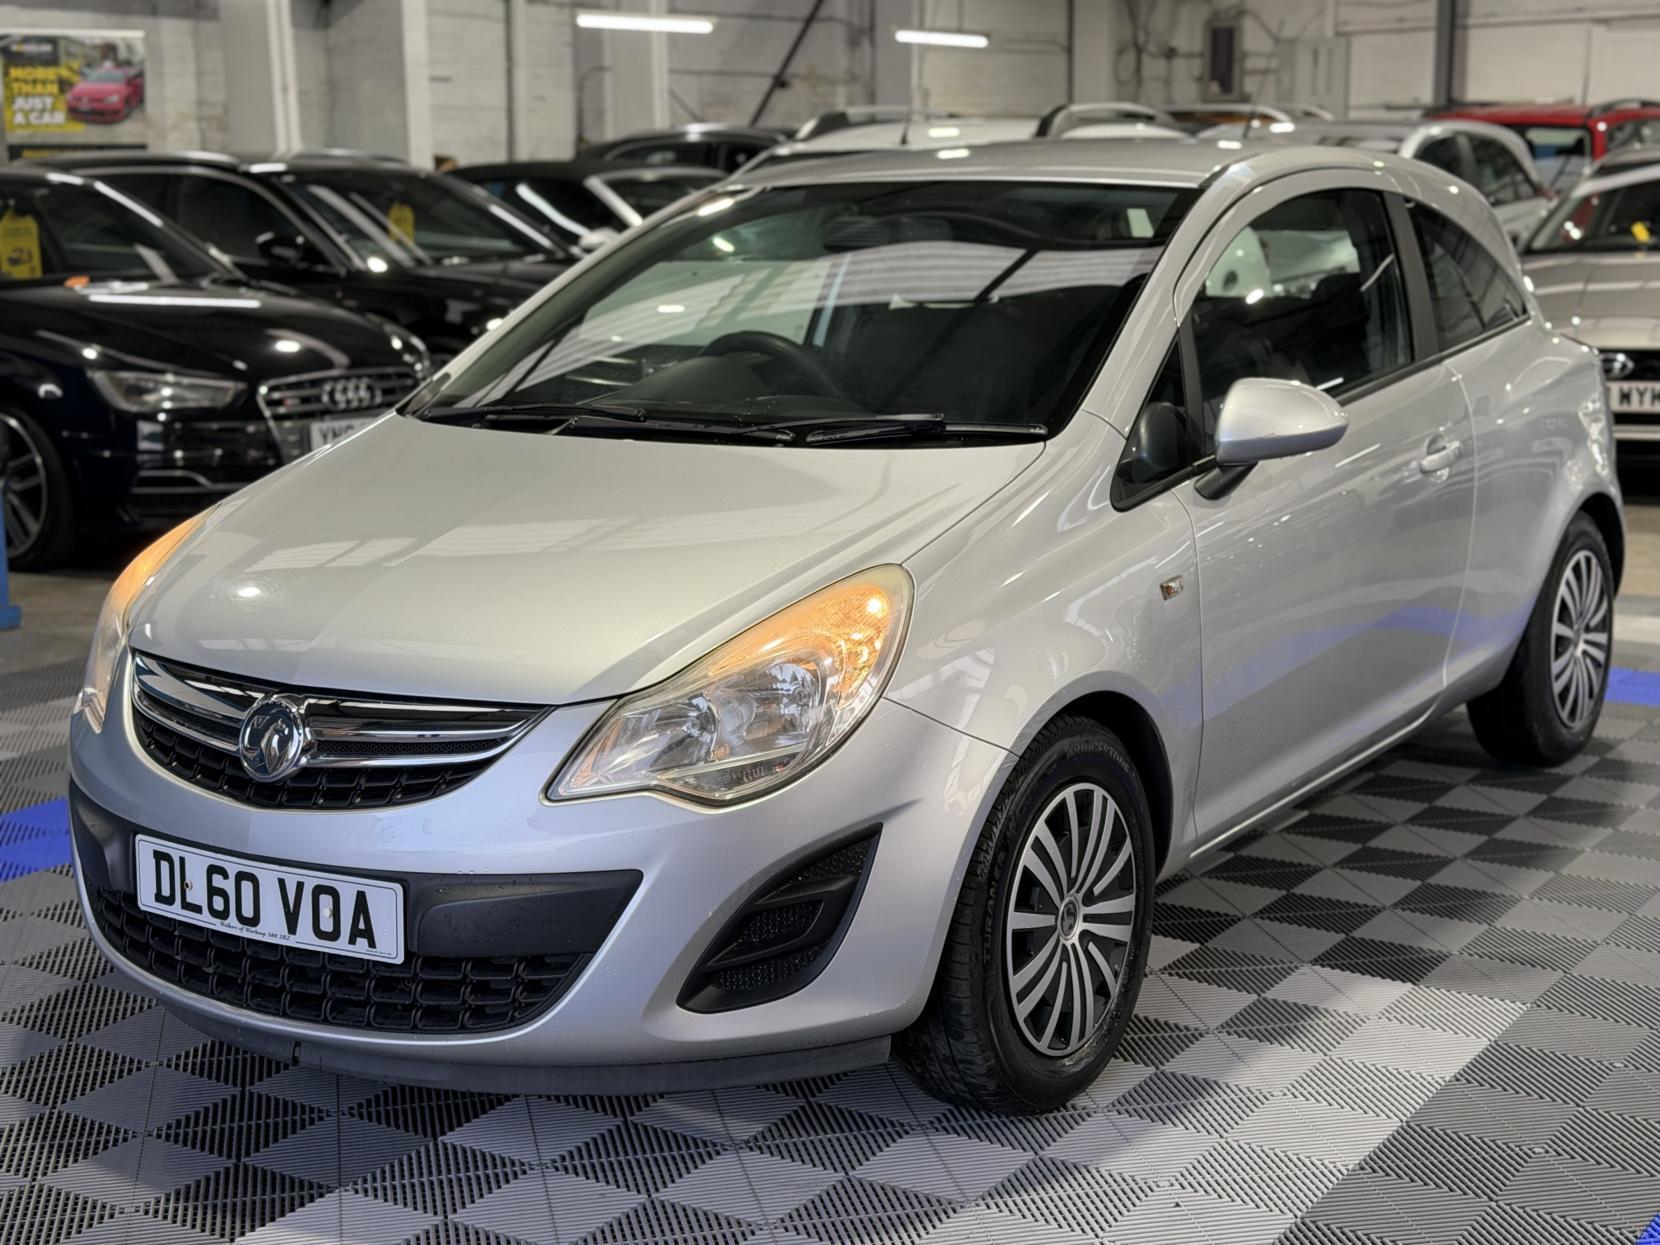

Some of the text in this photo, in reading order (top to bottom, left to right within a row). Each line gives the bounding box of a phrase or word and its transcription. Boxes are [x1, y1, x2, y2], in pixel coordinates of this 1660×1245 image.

[9, 66, 59, 79] MORE
[11, 82, 58, 94] THAN
[13, 95, 53, 110] JUST
[13, 111, 66, 125] A CAR
[152, 849, 377, 949] DL60 VOA
